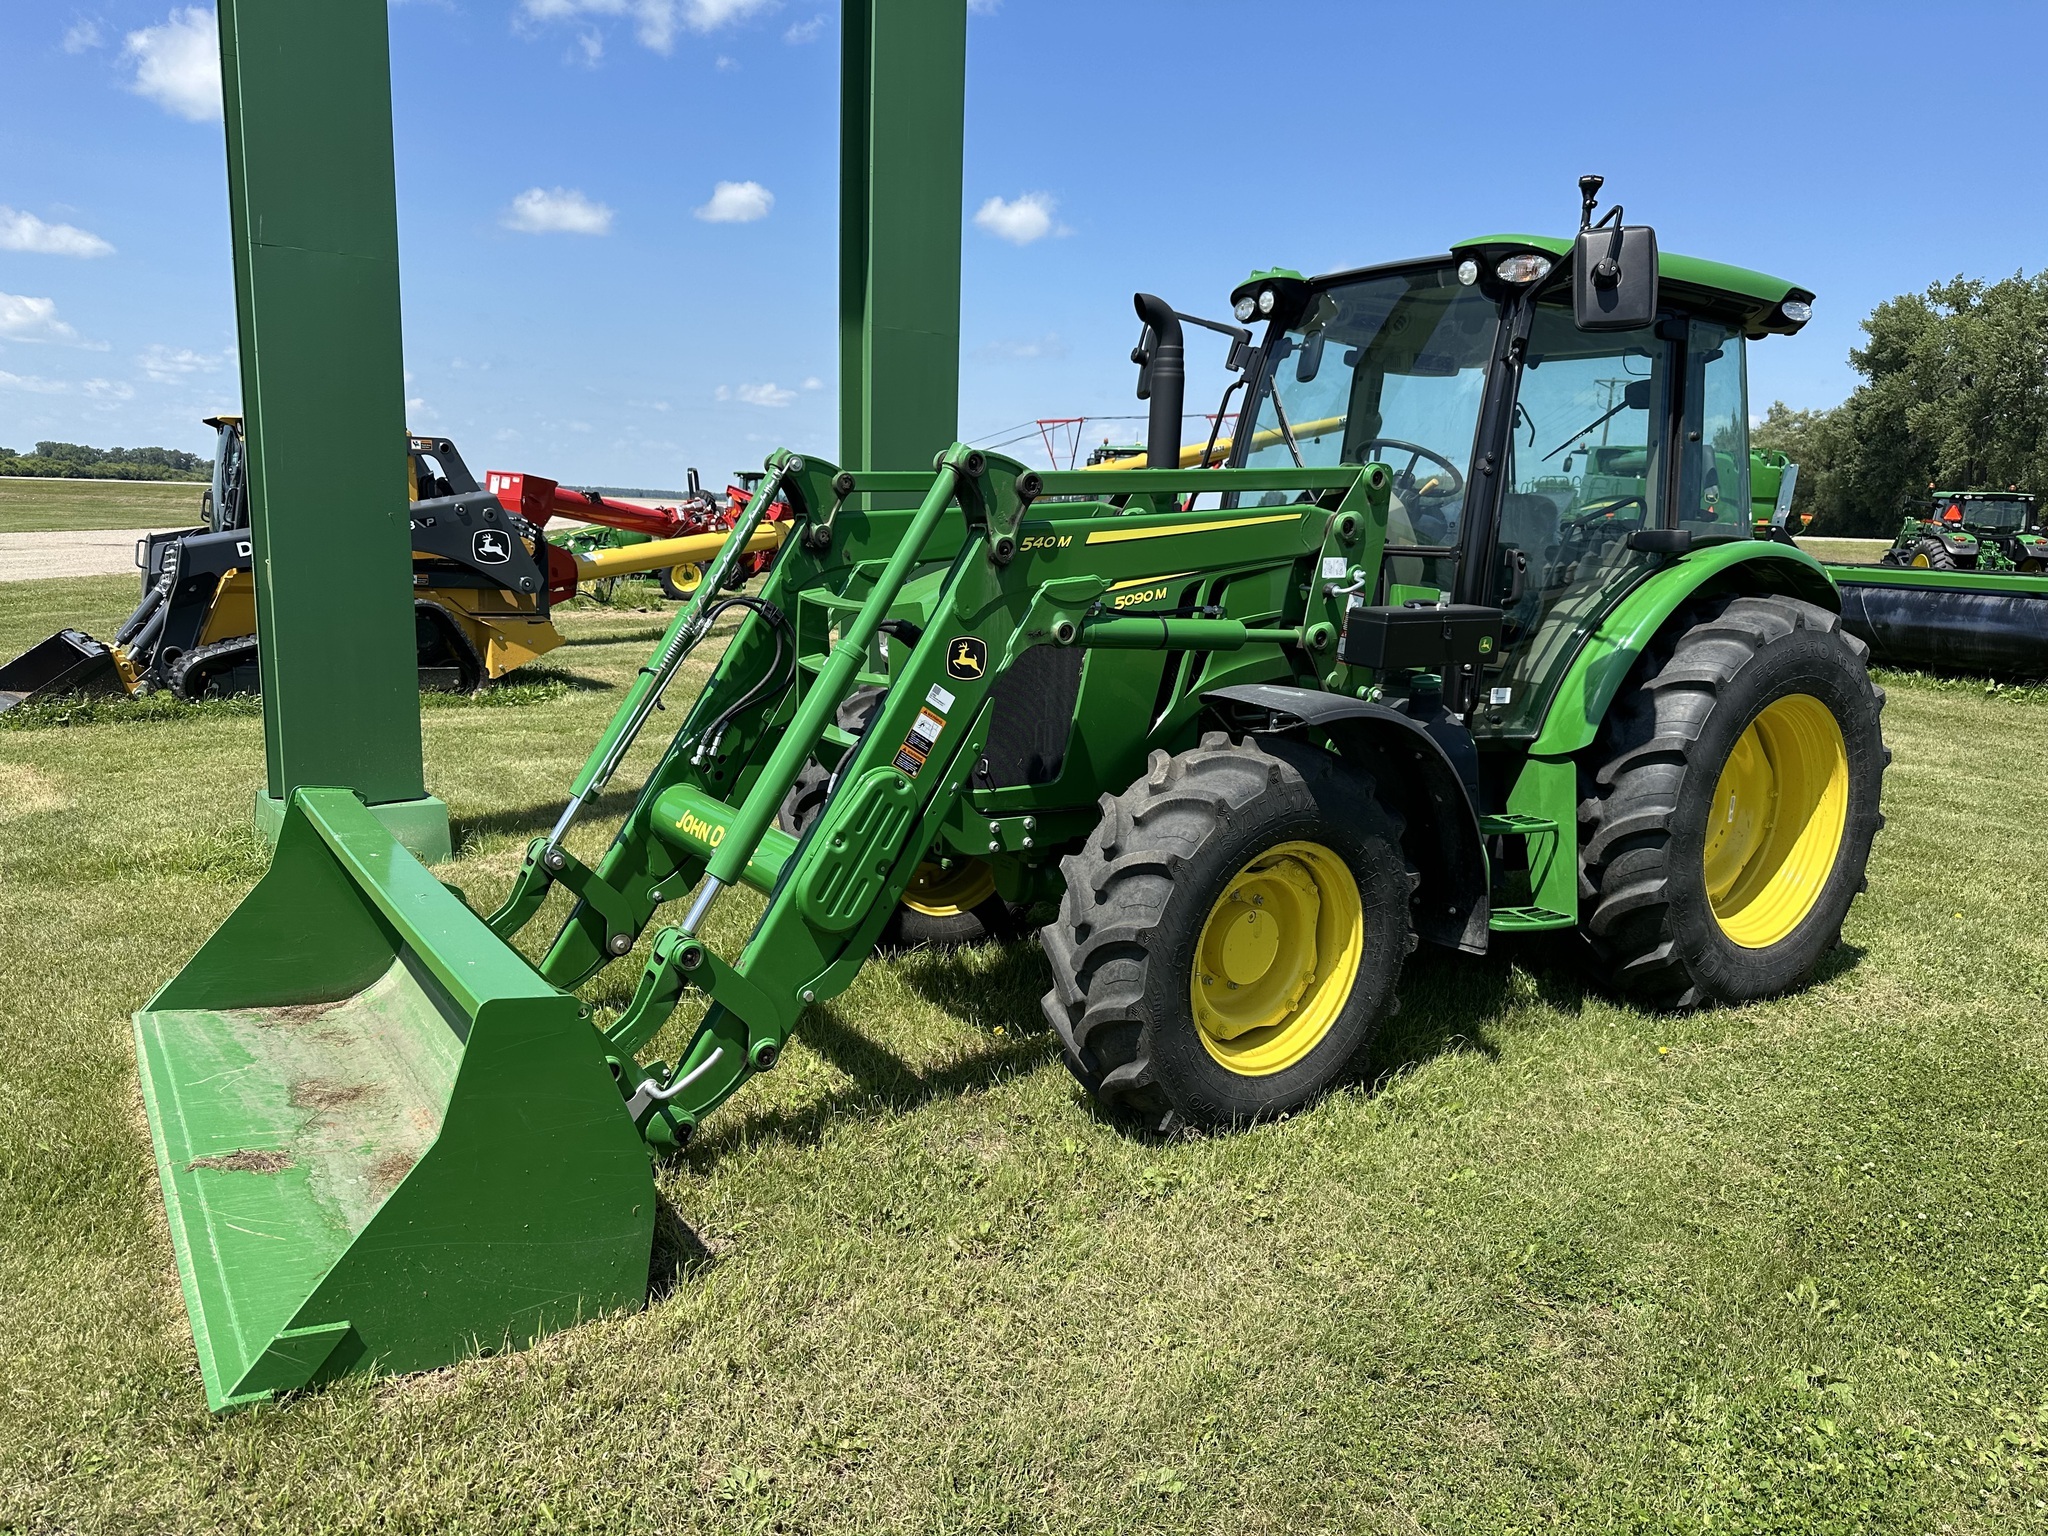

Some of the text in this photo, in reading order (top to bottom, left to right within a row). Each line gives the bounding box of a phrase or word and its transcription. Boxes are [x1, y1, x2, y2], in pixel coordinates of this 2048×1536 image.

[1020, 535, 1073, 551] 540 M
[1114, 587, 1168, 609] 5090 M
[1796, 640, 1830, 660] PRO
[675, 809, 712, 843] JOHN
